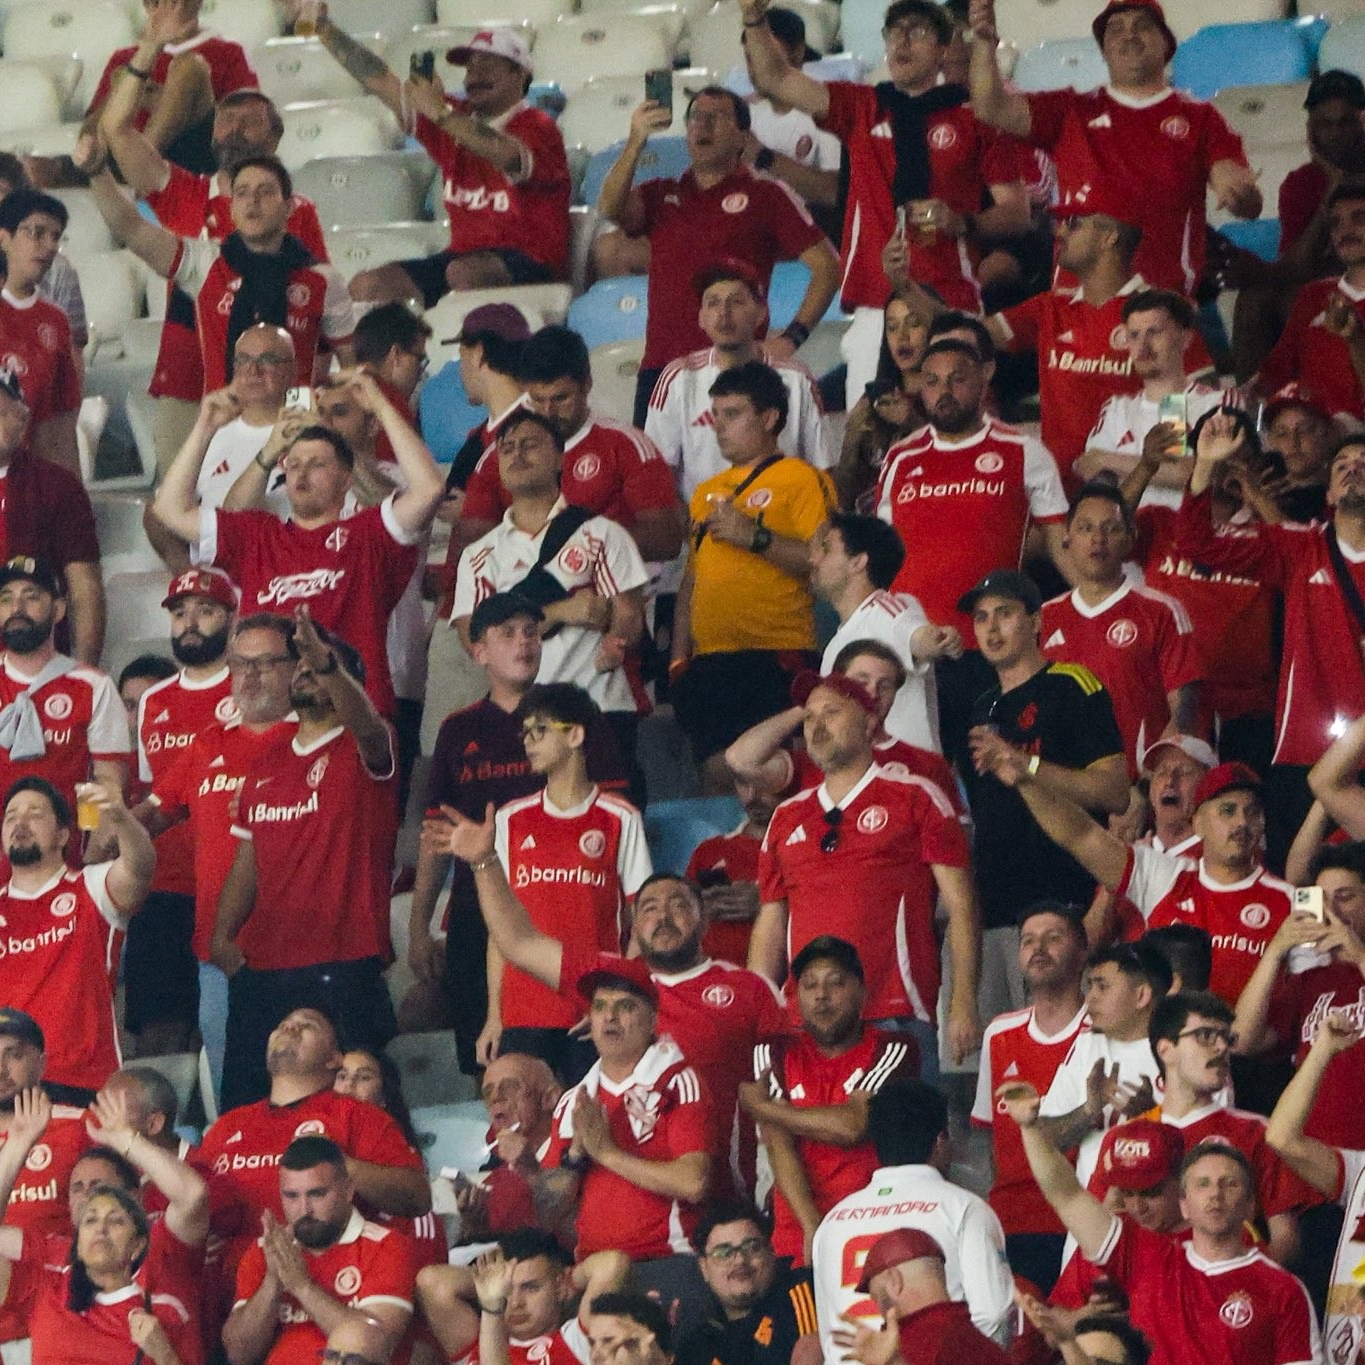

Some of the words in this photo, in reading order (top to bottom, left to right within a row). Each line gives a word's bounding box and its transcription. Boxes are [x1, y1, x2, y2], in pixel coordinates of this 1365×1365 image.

[919, 479, 1006, 499] banrisul
[531, 865, 607, 889] banrisul
[1211, 933, 1267, 957] nrisul
[232, 1152, 282, 1170] banr
[10, 1178, 58, 1206] risul
